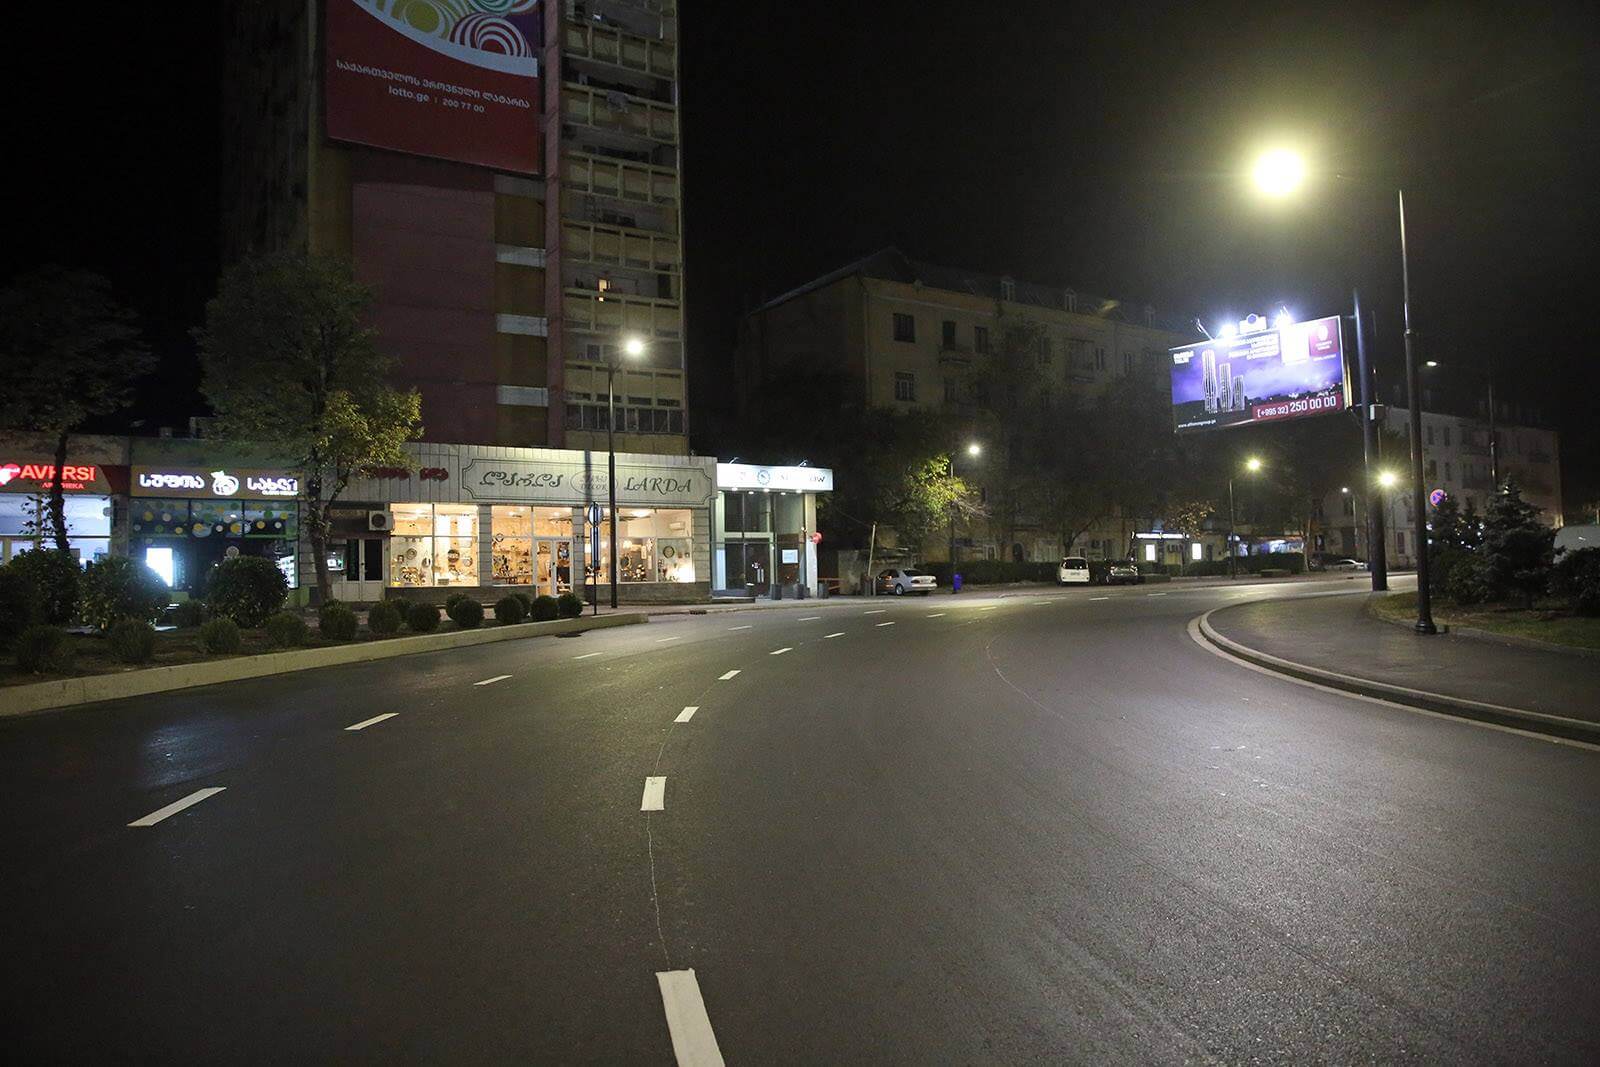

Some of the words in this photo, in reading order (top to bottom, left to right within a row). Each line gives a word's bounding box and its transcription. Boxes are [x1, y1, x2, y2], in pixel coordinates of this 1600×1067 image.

[388, 85, 430, 102] lotto.ge
[1290, 400, 1308, 413] 250
[1309, 398, 1322, 410] 00
[1324, 395, 1336, 407] 00
[624, 477, 692, 495] LARDA
